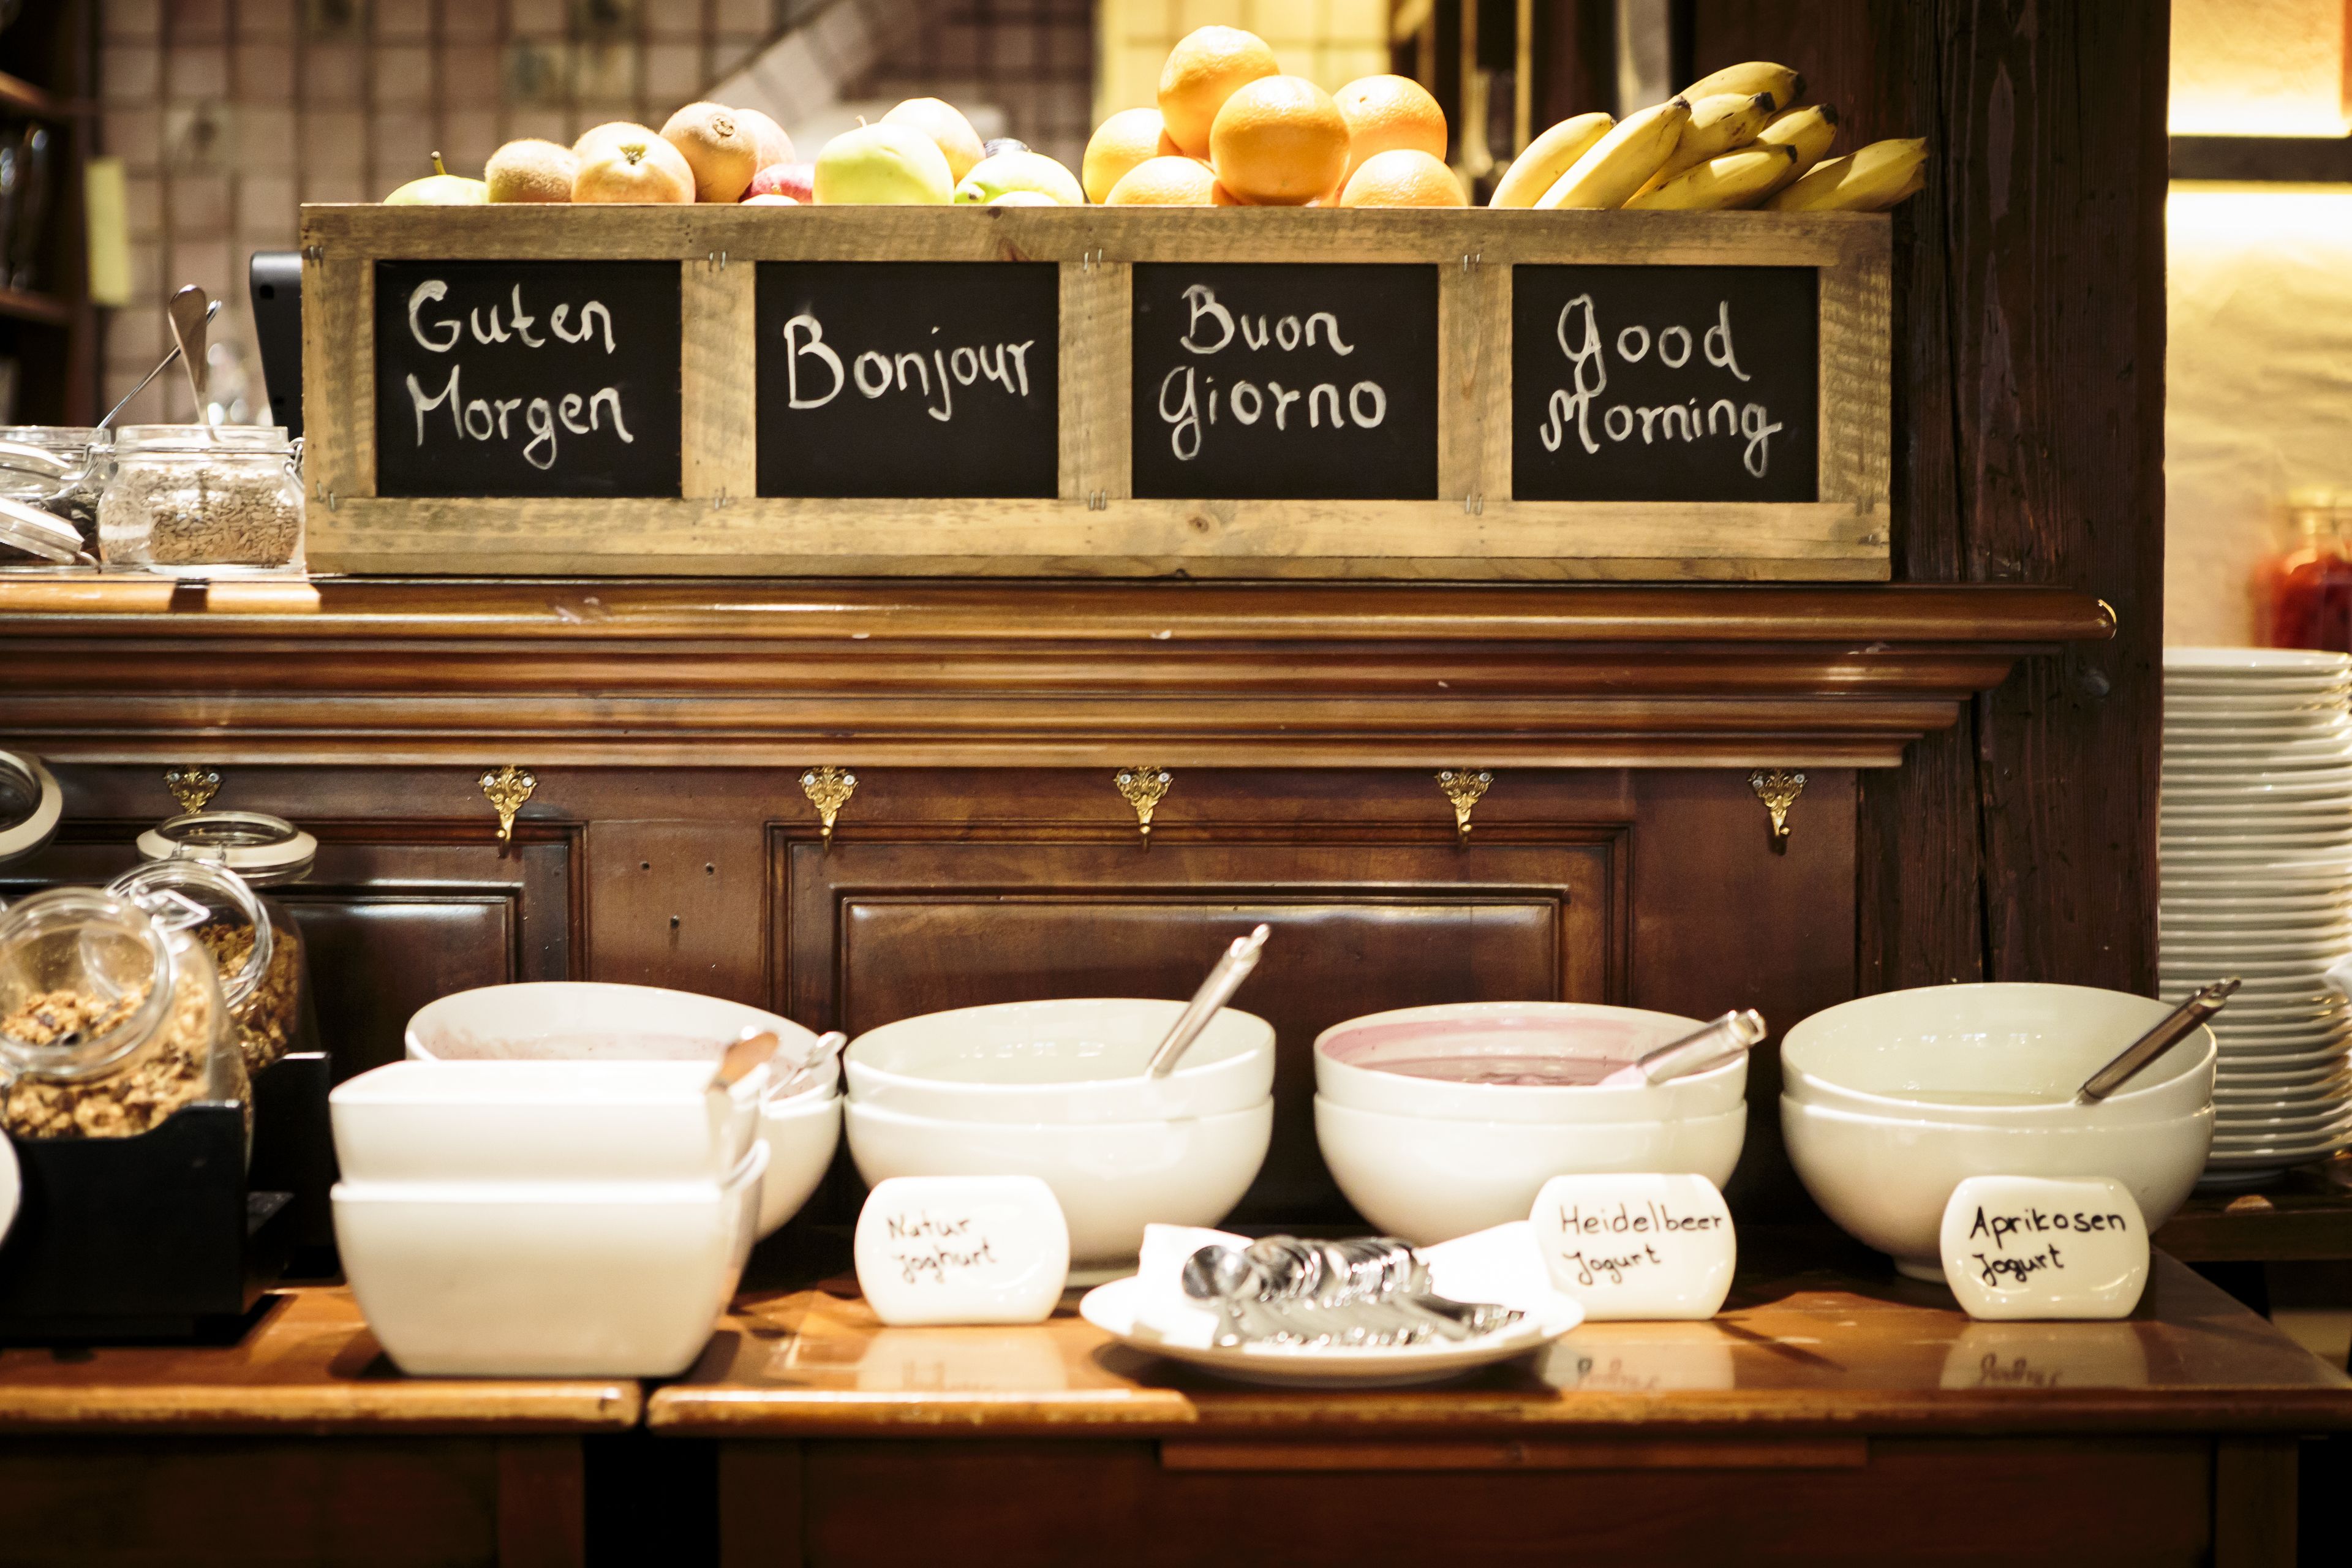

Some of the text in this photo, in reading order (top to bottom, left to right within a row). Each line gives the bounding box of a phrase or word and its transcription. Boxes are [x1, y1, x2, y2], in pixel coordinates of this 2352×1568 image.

[409, 280, 615, 353] Guten
[1180, 284, 1354, 355] Buon
[783, 315, 1035, 421] Bonjour
[406, 365, 633, 470] Morgen
[1540, 389, 1782, 477] Morning
[887, 1210, 969, 1240] Natur
[1560, 1202, 1722, 1235] Heidelbeer
[1970, 1205, 2126, 1249] Aprikosen
[1972, 1244, 2064, 1287] Jogurt
